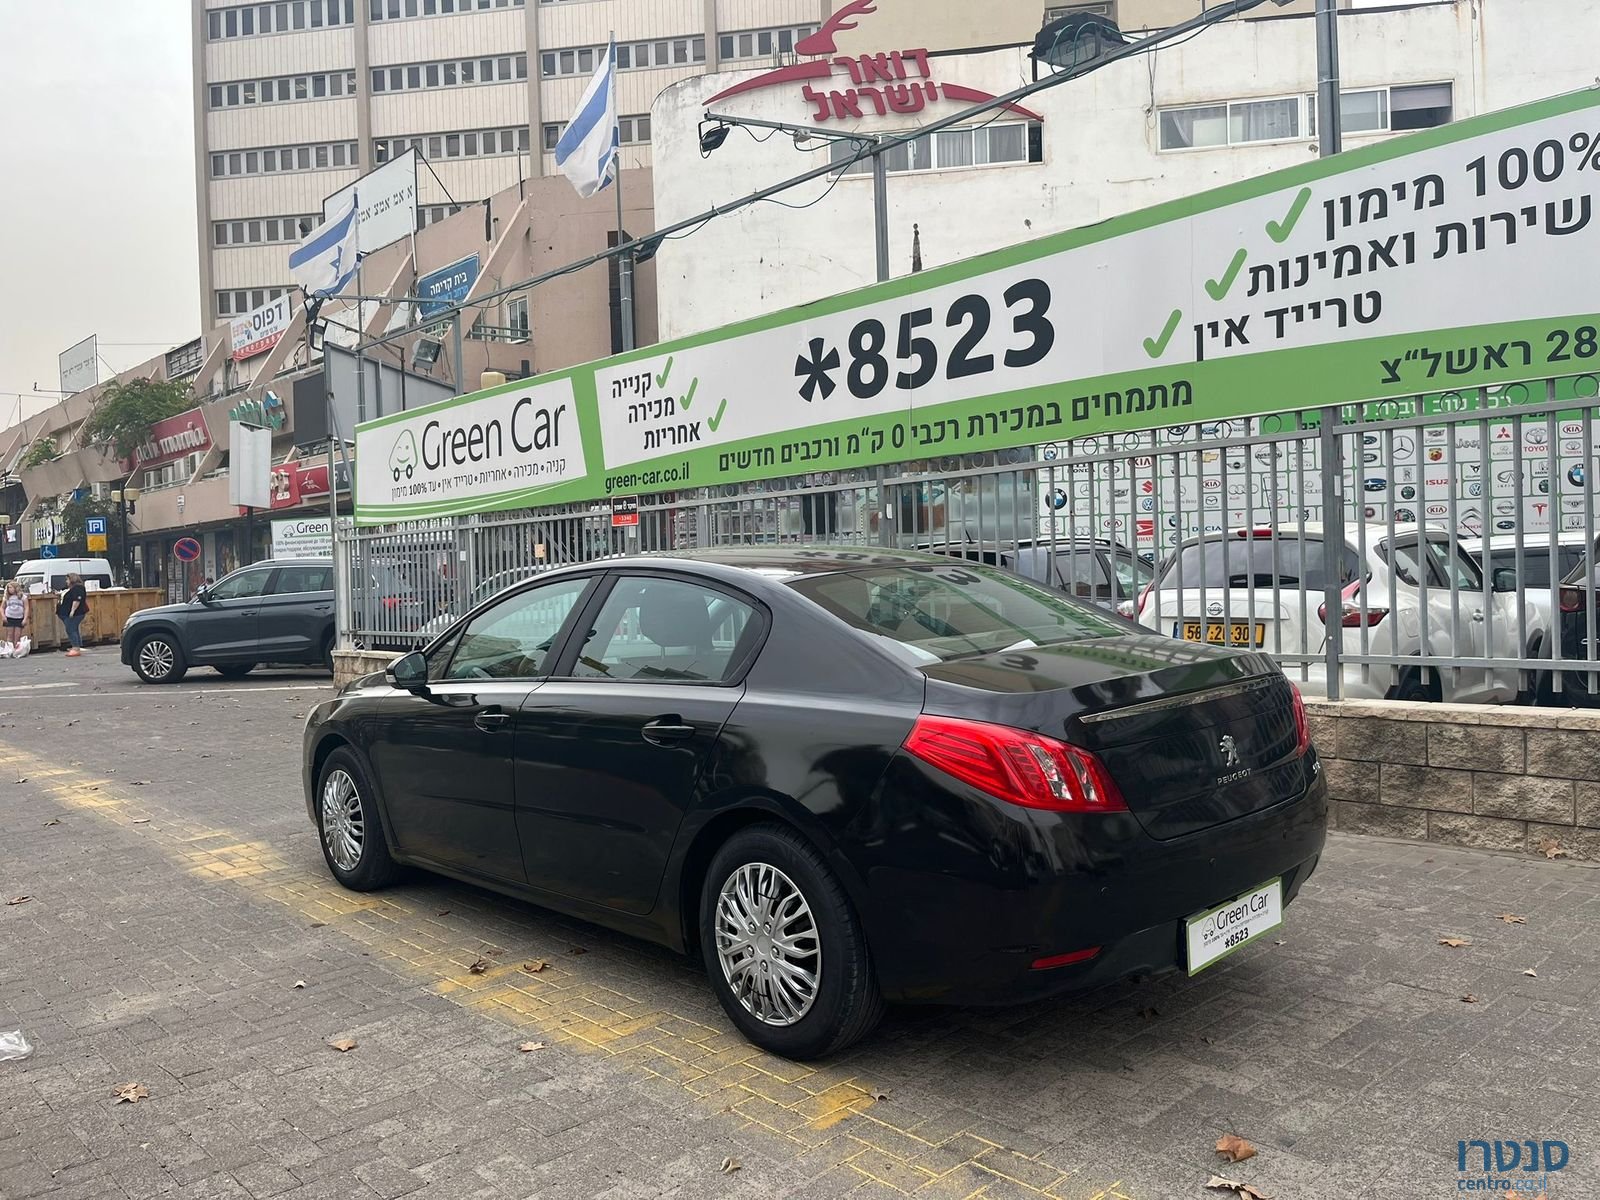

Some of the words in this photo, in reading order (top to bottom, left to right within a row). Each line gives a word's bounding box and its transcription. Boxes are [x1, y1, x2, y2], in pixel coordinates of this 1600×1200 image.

[833, 48, 930, 84] דואר
[802, 81, 939, 121] ישראל
[1465, 131, 1600, 198] 100%
[1322, 173, 1445, 241] מימון
[1432, 194, 1592, 259] שירות
[1247, 231, 1416, 298] ואמינות
[430, 277, 452, 296] קדימה
[454, 271, 468, 286] בית
[252, 302, 283, 332] דפוס
[1264, 289, 1382, 339] טרייד
[1193, 314, 1250, 361] אין
[1546, 326, 1598, 362] 28
[612, 372, 651, 398] קנייה
[628, 396, 674, 423] מכירה
[1072, 380, 1192, 422] מתמחים
[911, 419, 959, 446] רכבי
[967, 402, 1062, 438] במכירת
[1566, 425, 1580, 433] KIA
[421, 419, 503, 471] Green
[510, 397, 566, 454] Car
[643, 421, 701, 450] אחריות
[719, 447, 775, 472] חדשים
[781, 437, 839, 463] ורכבים
[1524, 445, 1549, 453] TOYOT
[453, 473, 473, 487] טרייד
[479, 469, 507, 484] אחריות
[513, 465, 539, 479] מכירה
[546, 458, 566, 475] קניה
[605, 462, 689, 493] green-car.co.il
[409, 483, 428, 496] 100%
[428, 481, 436, 492] עד
[1425, 478, 1458, 486] ISUZ
[296, 521, 329, 534] Green
[1216, 768, 1251, 785] PEUGEOT
[1216, 903, 1248, 930] Green
[1250, 893, 1269, 913] Car
